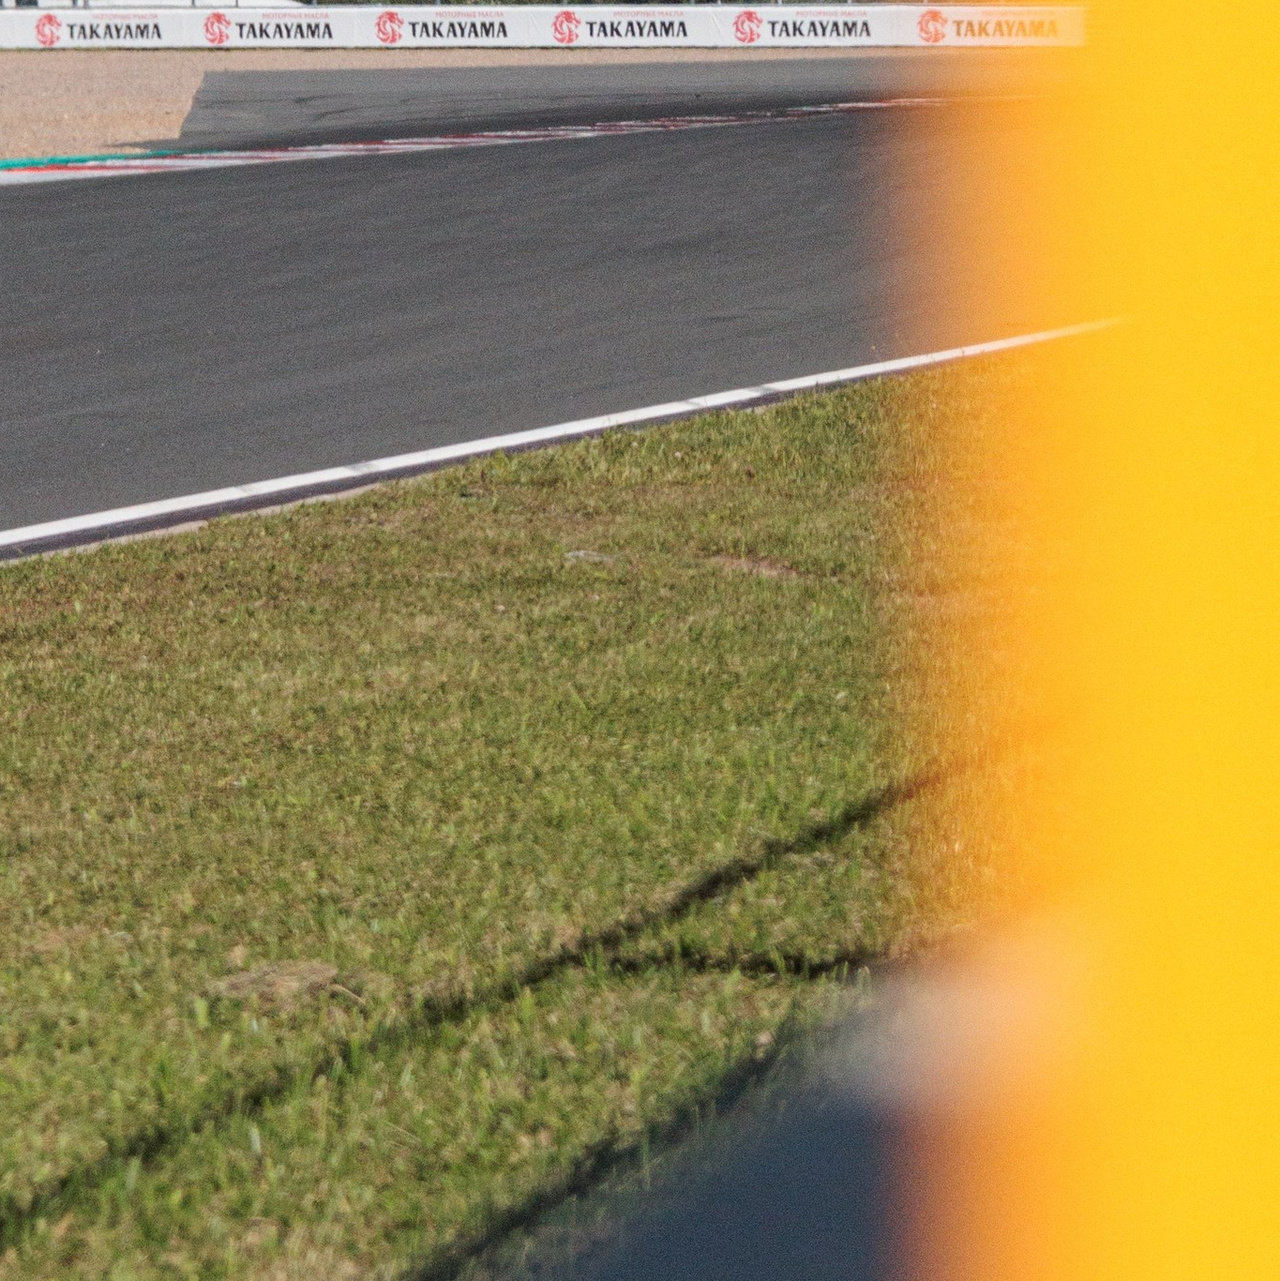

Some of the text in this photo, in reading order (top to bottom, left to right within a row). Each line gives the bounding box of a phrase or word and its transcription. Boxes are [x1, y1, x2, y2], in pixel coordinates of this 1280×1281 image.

[67, 23, 162, 40] TAKAYAMA
[236, 22, 333, 39] TAKAYAMA
[409, 21, 508, 38] TAKAYAMA
[586, 20, 688, 37] TAKAYAMA
[768, 20, 871, 37] TAKAYAMA
[953, 20, 1058, 38] TAKAYAMA
